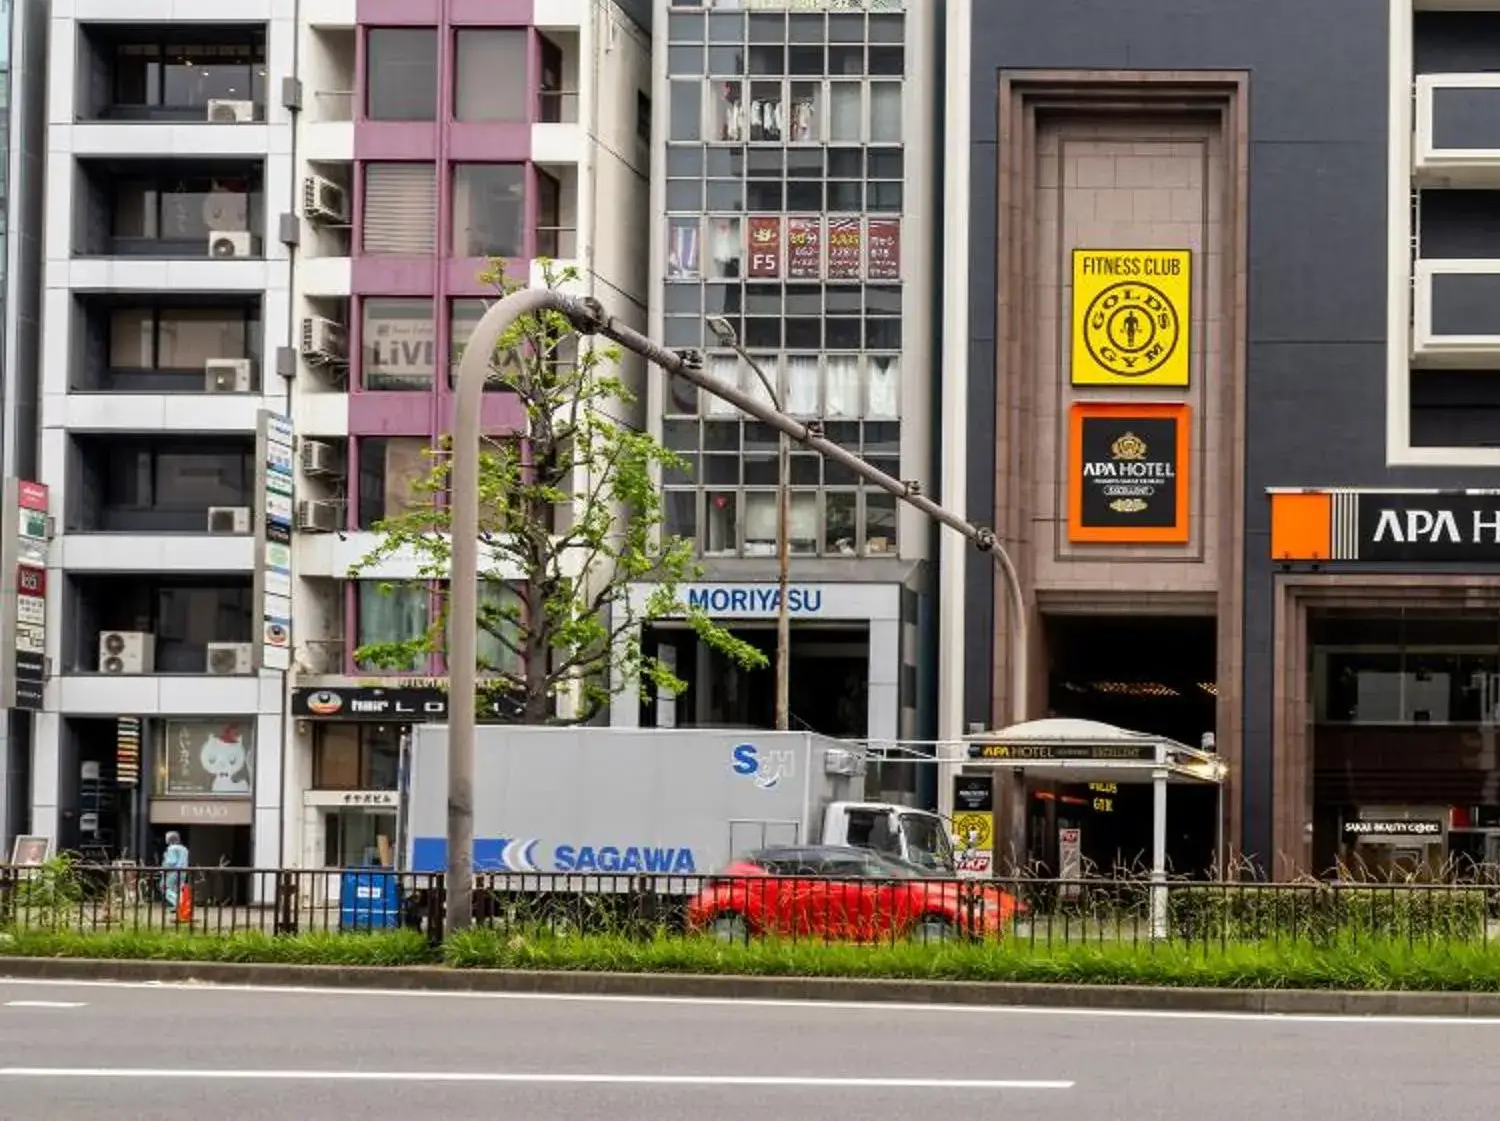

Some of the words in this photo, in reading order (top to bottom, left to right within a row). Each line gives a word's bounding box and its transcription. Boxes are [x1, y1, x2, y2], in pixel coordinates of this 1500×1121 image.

[753, 254, 775, 270] F5
[1083, 257, 1140, 275] FITNESS
[1144, 257, 1181, 275] CLUB
[1092, 289, 1171, 330] GOLD'S
[1100, 343, 1163, 368] GYM
[1083, 463, 1117, 476] APA
[1119, 463, 1175, 477] HOTEL
[1373, 510, 1462, 543] APA
[689, 588, 822, 612] MORIYASU
[1012, 746, 1055, 758] HOTEL
[554, 844, 696, 873] SAGAWA
